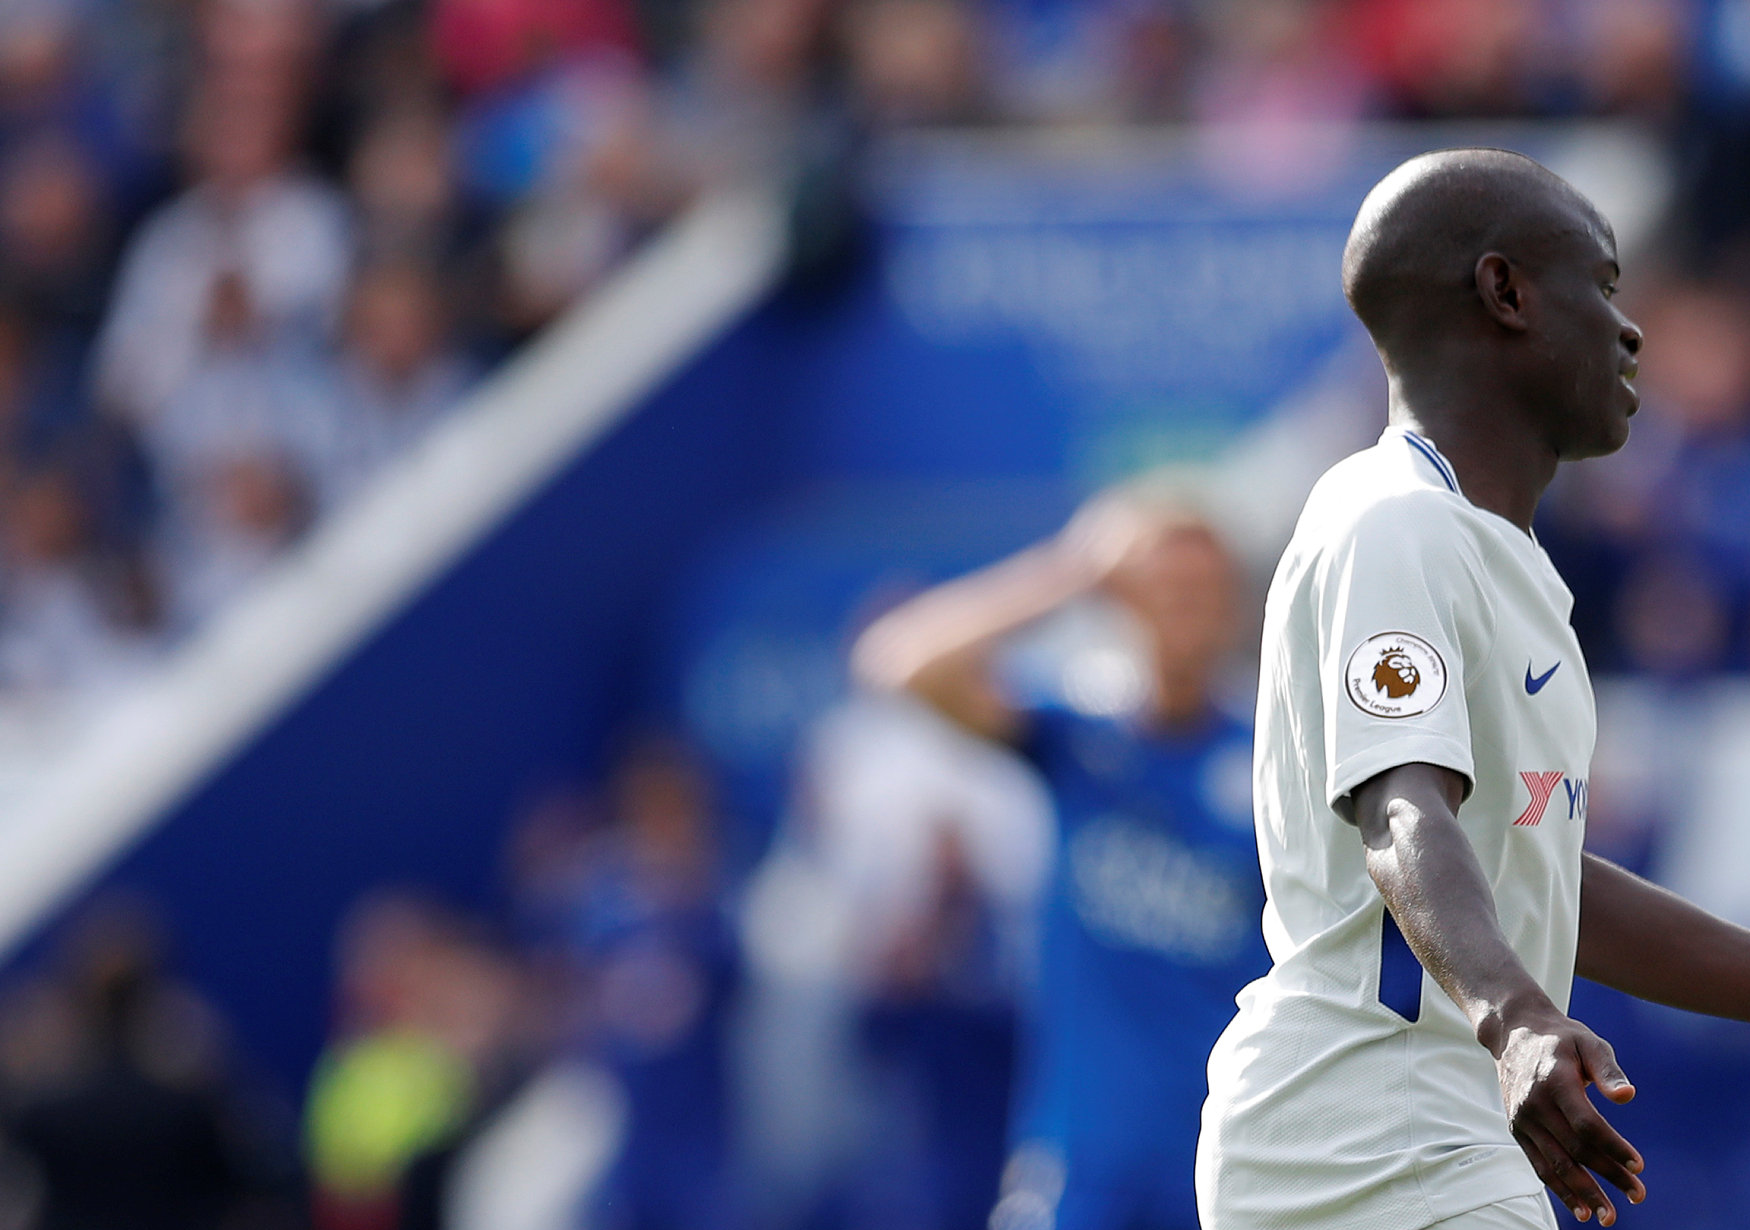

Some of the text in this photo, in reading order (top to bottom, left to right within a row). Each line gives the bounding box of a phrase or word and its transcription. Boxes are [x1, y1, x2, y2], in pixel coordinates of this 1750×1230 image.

[1354, 678, 1402, 713] Premier League
[1563, 778, 1588, 820] YO
